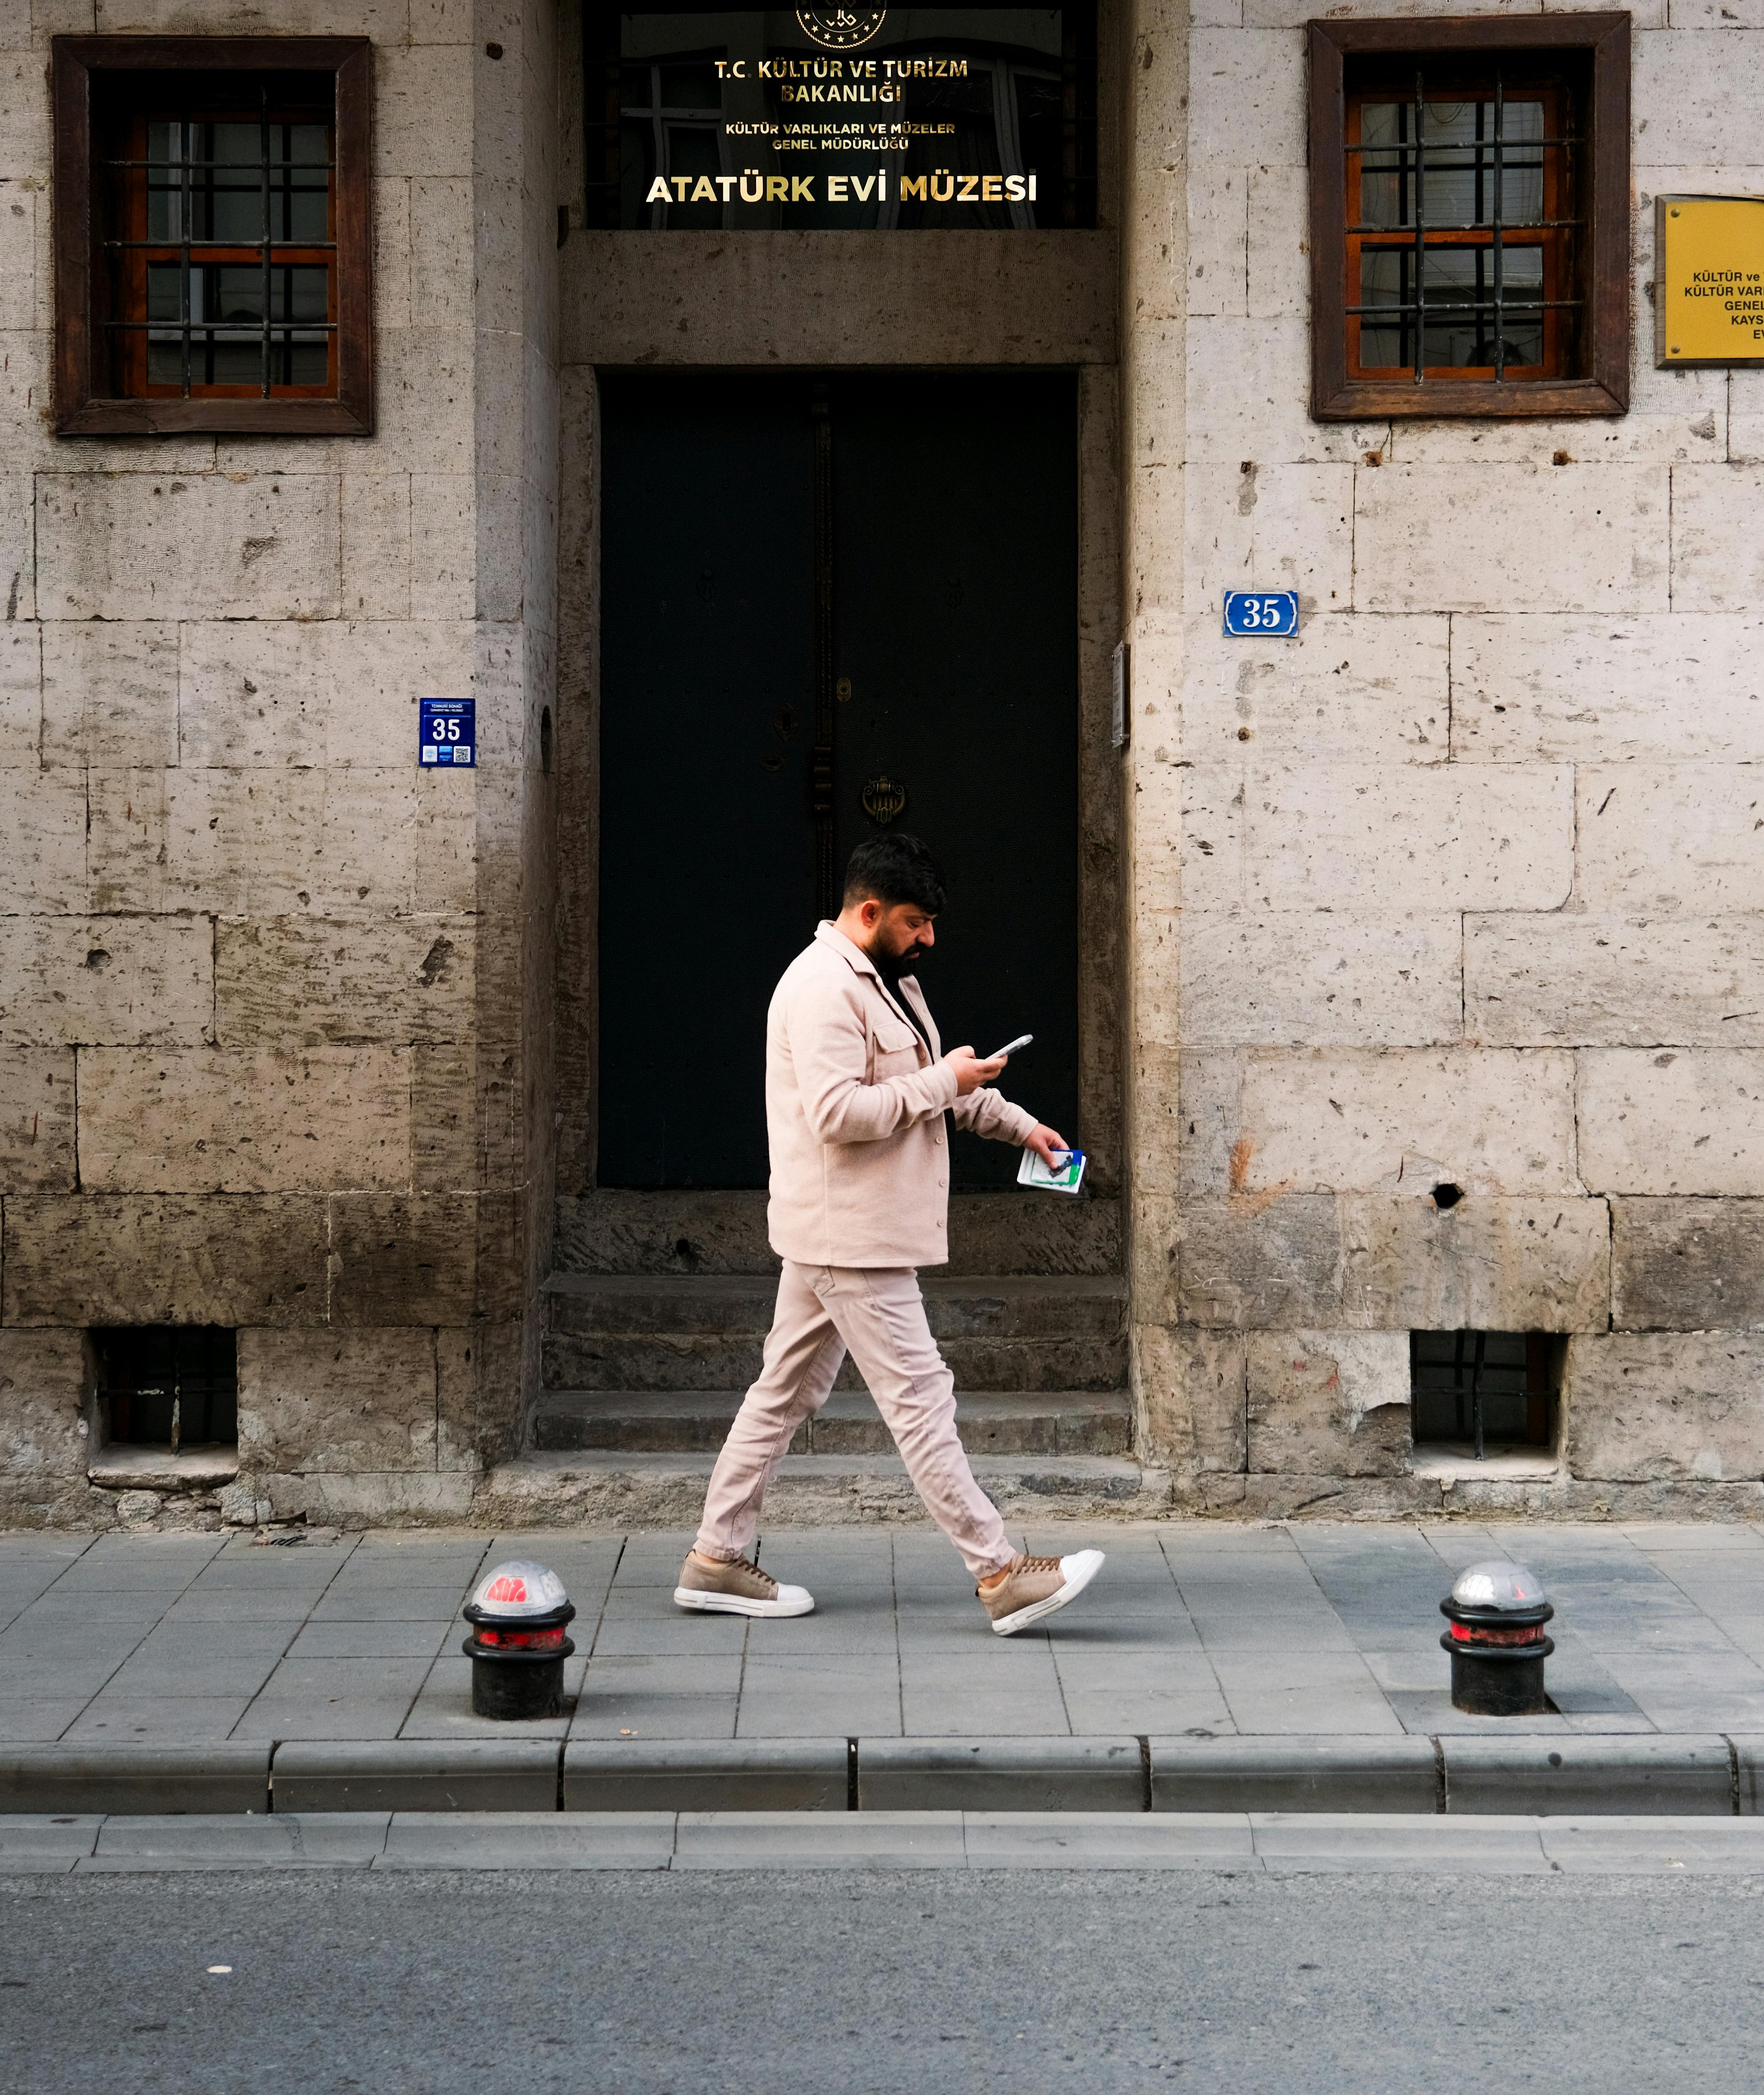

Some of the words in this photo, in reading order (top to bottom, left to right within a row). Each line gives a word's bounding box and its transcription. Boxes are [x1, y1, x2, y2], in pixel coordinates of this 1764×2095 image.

[714, 61, 752, 78] T.C.
[758, 57, 842, 78] KÜLTÜR
[849, 60, 876, 78] VE
[882, 56, 967, 78] TURİZM
[781, 81, 901, 103] BAKANLIĞI
[726, 121, 779, 134] KÜLTÜR
[783, 123, 864, 134] VARLIKLARI
[868, 123, 887, 134] VE
[891, 121, 955, 134] MÜZELER
[772, 139, 817, 150] GENEL
[821, 136, 908, 150] MÜDÜRLÜĞÜ
[646, 169, 815, 202] ATATÜRK
[828, 169, 886, 202] EVİ
[900, 168, 1037, 202] MÜZESİ
[1693, 270, 1742, 282] KÜLTÜR
[1746, 273, 1760, 282] ve
[1685, 284, 1734, 297] KÜLTÜR
[1737, 286, 1764, 296] VAR
[1731, 315, 1764, 325] KAYS
[1243, 599, 1280, 628] 35
[433, 718, 460, 741] 35
